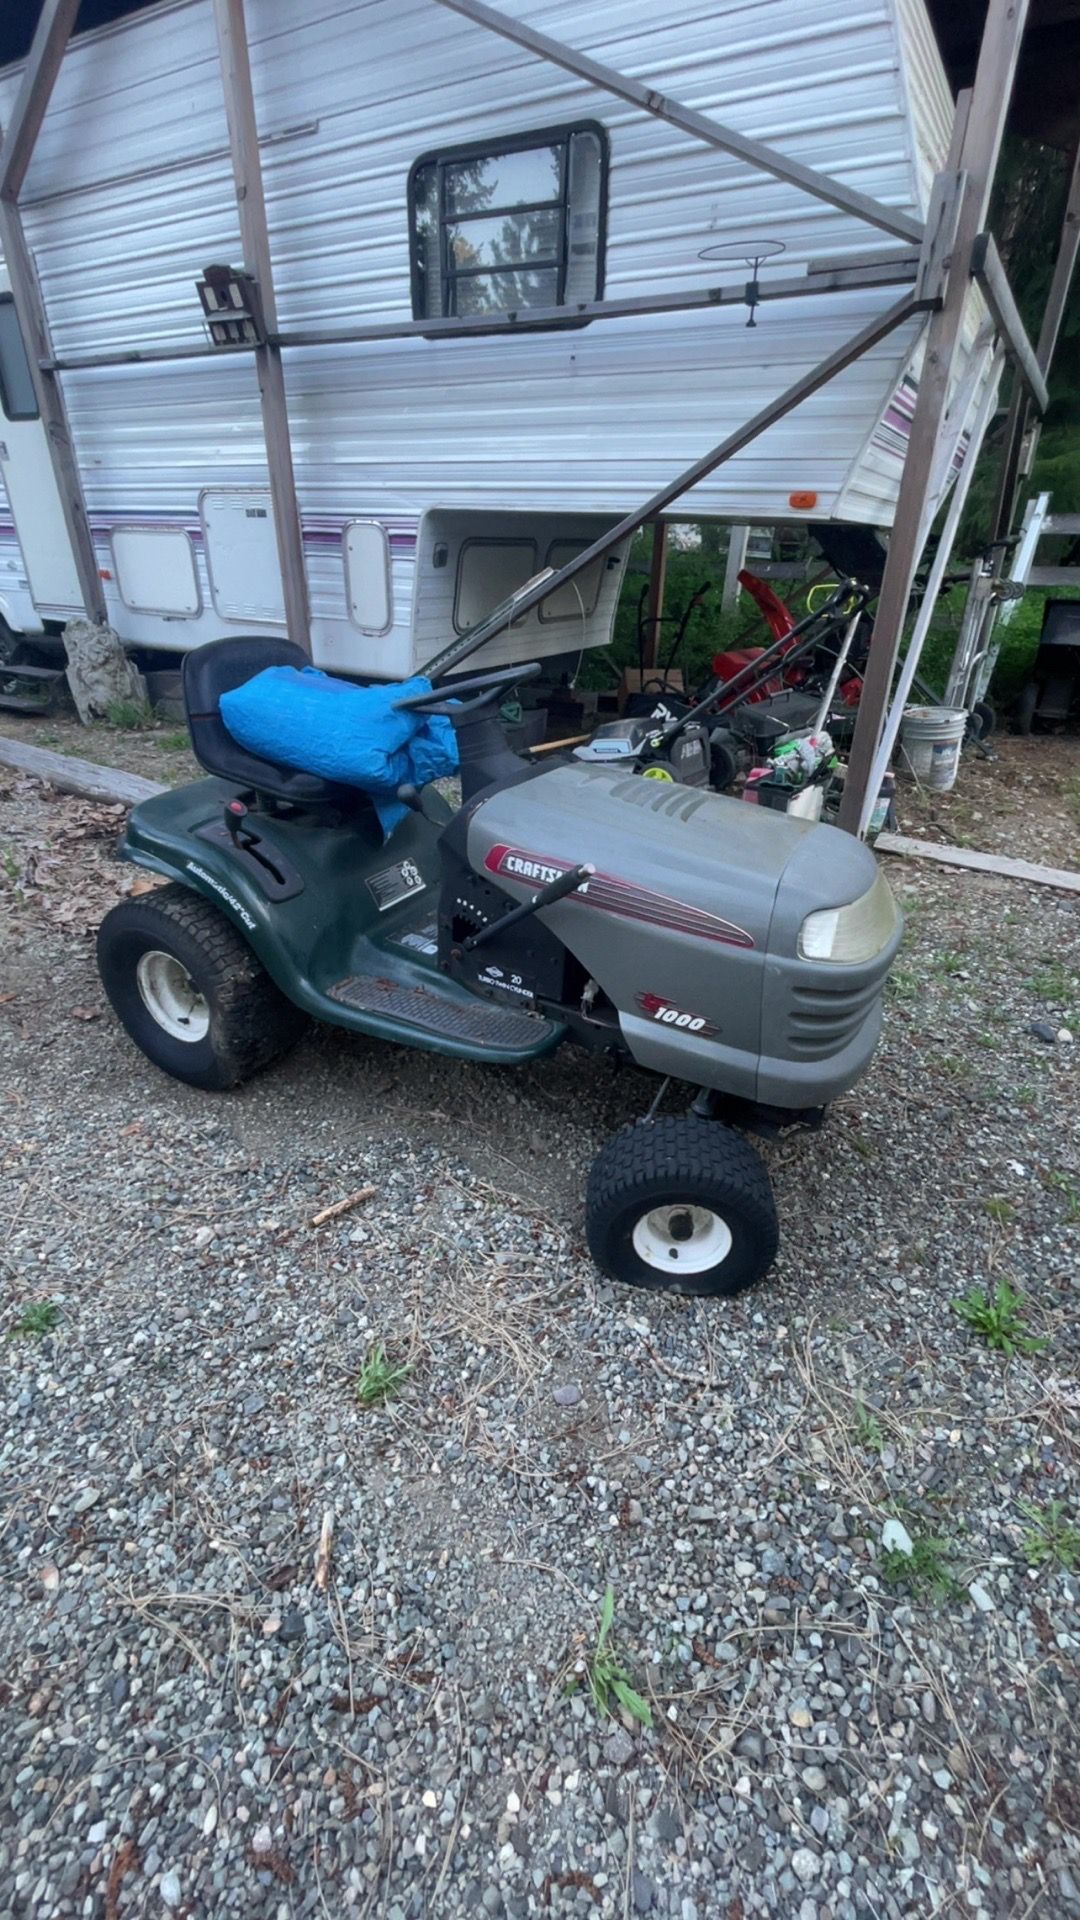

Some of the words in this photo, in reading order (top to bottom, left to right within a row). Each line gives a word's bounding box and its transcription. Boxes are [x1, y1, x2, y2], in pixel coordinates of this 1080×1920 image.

[506, 856, 589, 893] CRAFTSN
[511, 974, 522, 985] 20
[654, 1006, 706, 1030] 1000
